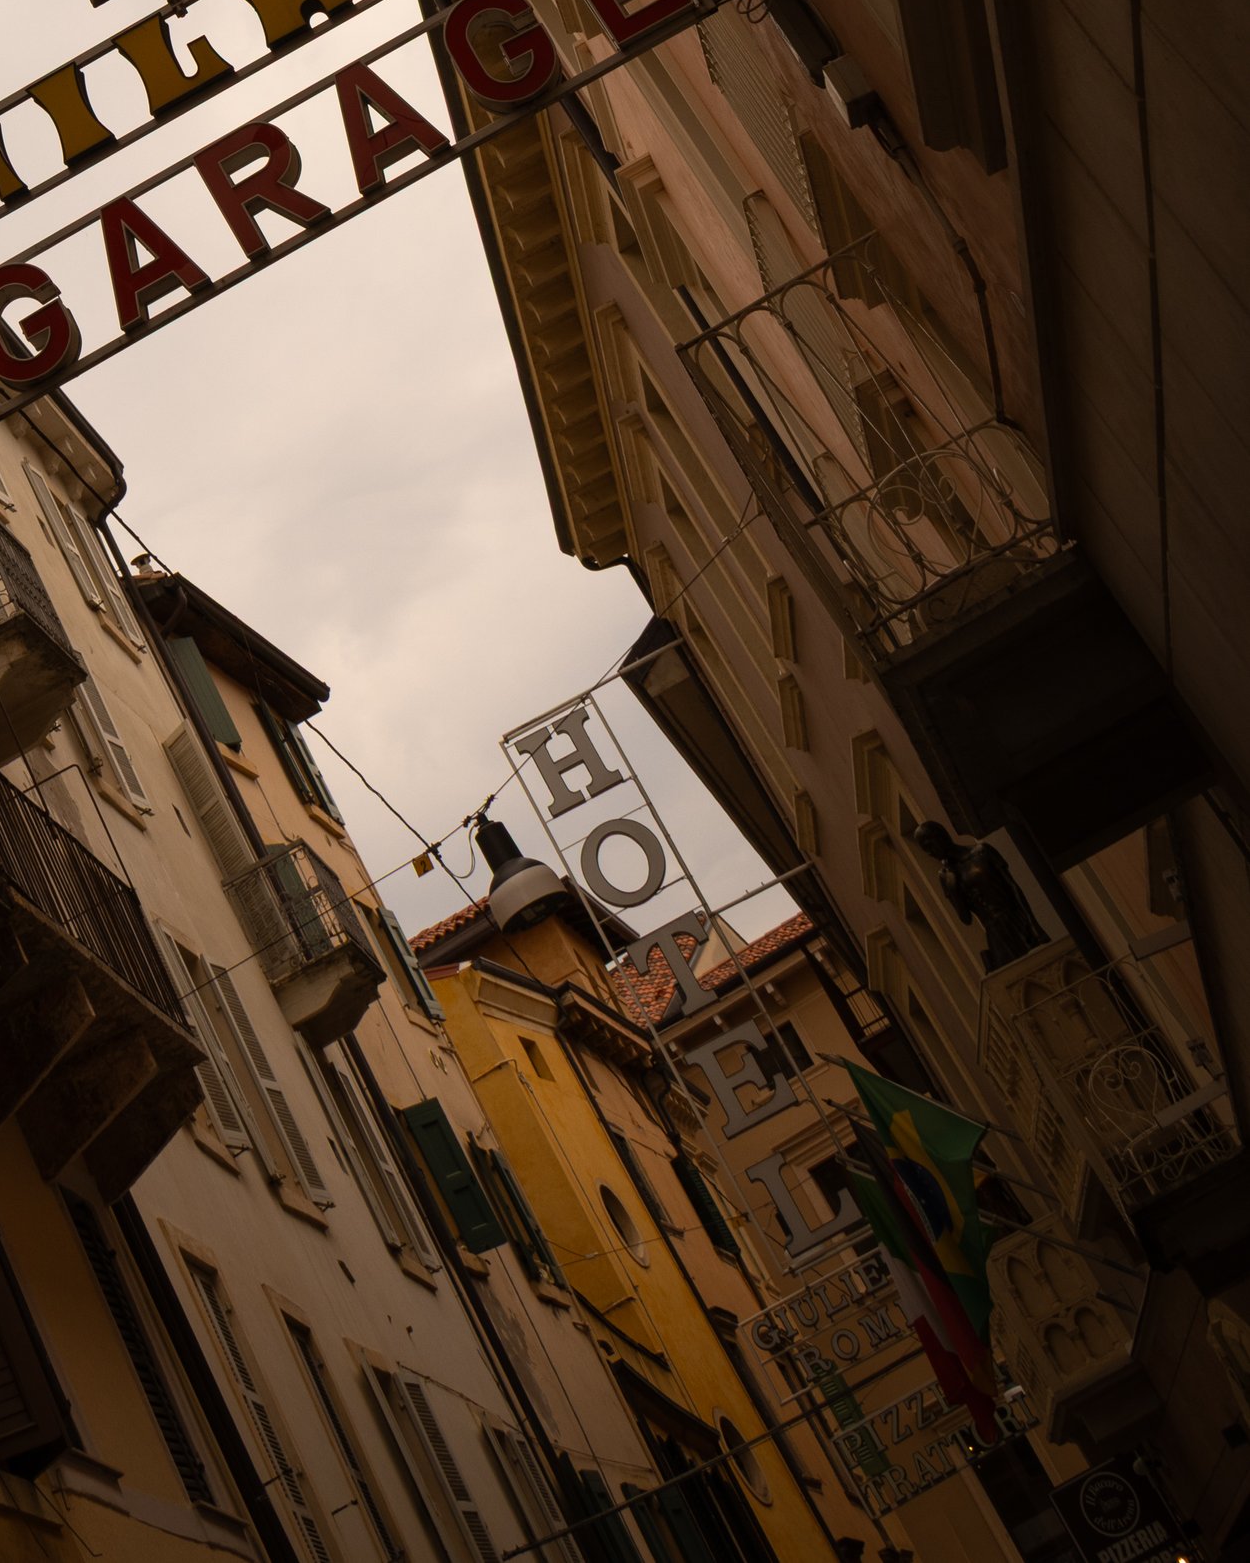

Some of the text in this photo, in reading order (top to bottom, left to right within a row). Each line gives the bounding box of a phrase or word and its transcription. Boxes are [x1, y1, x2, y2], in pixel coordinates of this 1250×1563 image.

[516, 708, 870, 1256] HOTEL
[750, 1253, 891, 1352] GIULIE
[792, 1294, 915, 1382] ROM
[1096, 1521, 1168, 1563] PIZZERIA
